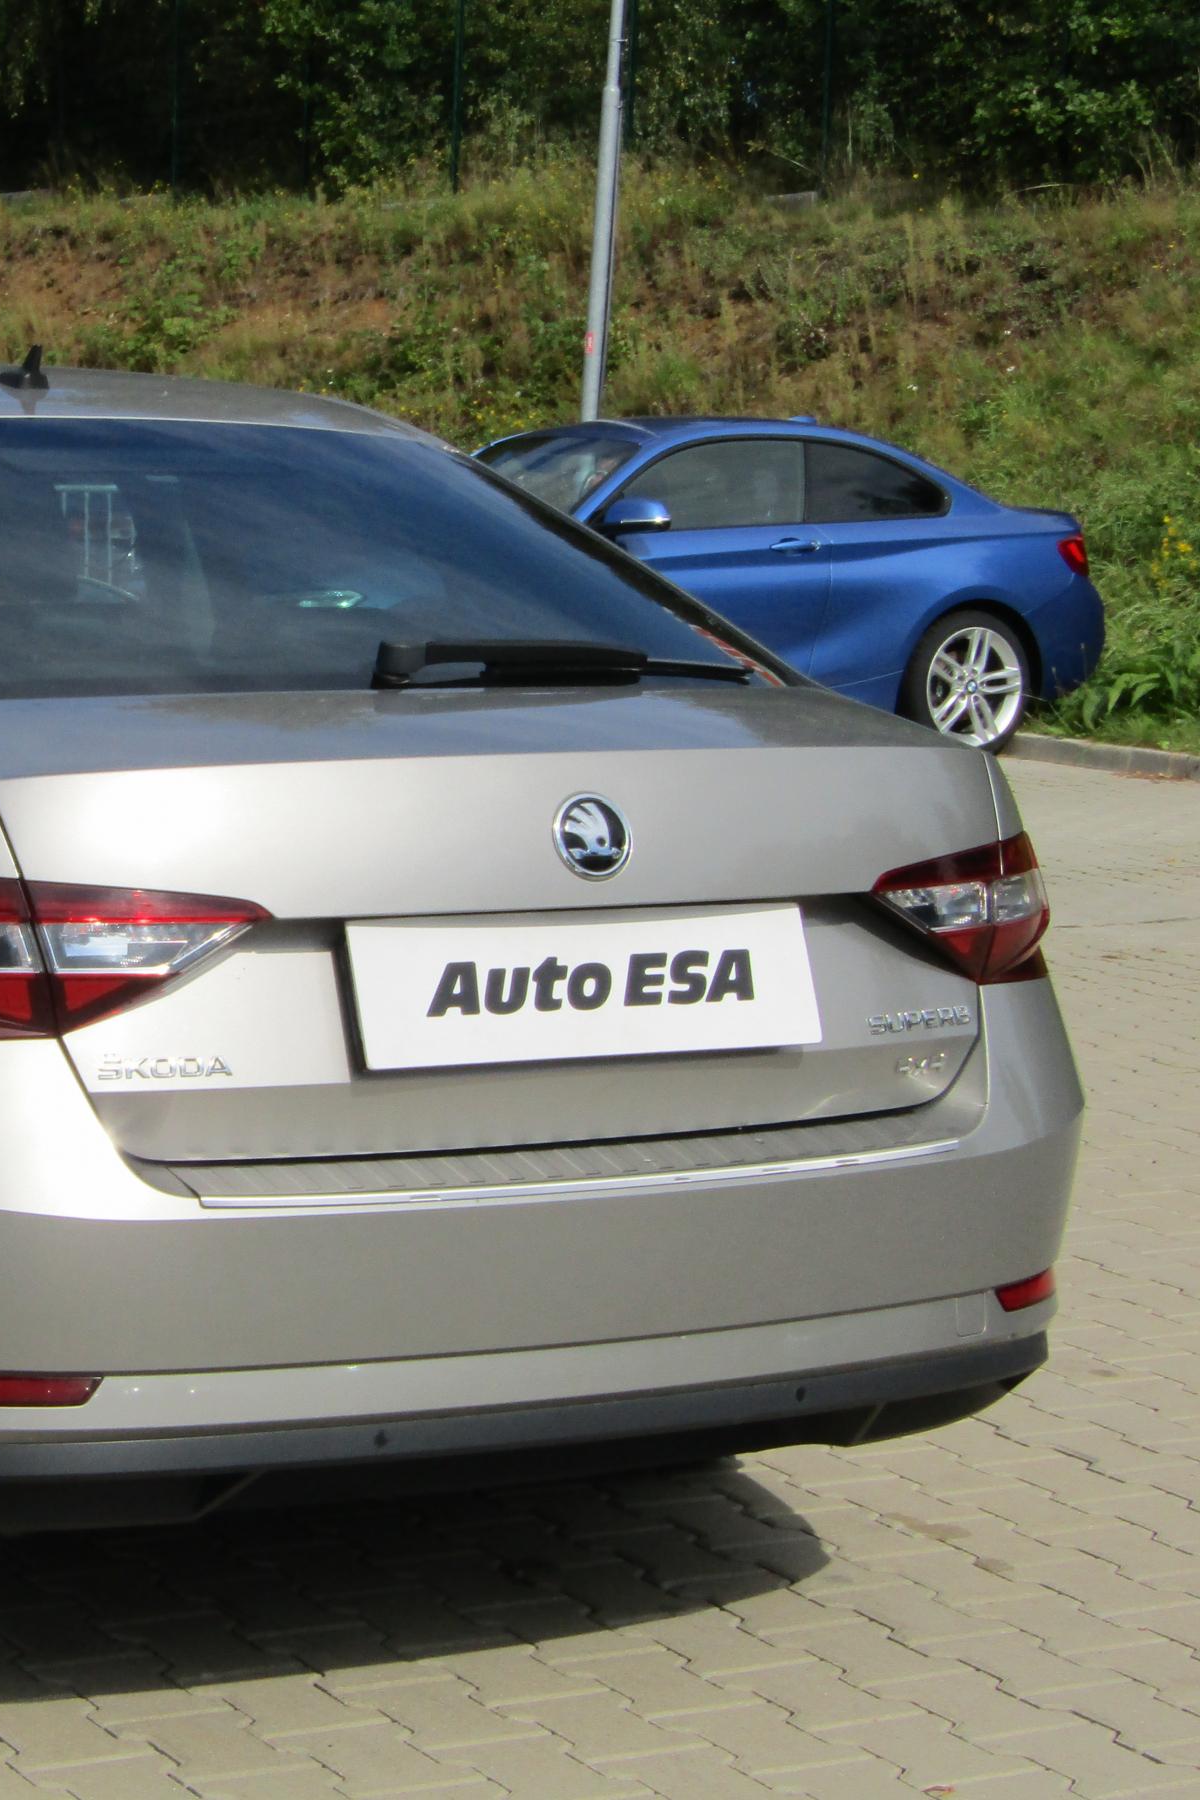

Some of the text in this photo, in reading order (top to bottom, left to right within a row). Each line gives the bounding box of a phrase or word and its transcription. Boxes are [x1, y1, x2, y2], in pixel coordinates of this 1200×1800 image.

[426, 948, 755, 1017] Auto ESA
[866, 1005, 971, 1036] SUPERB
